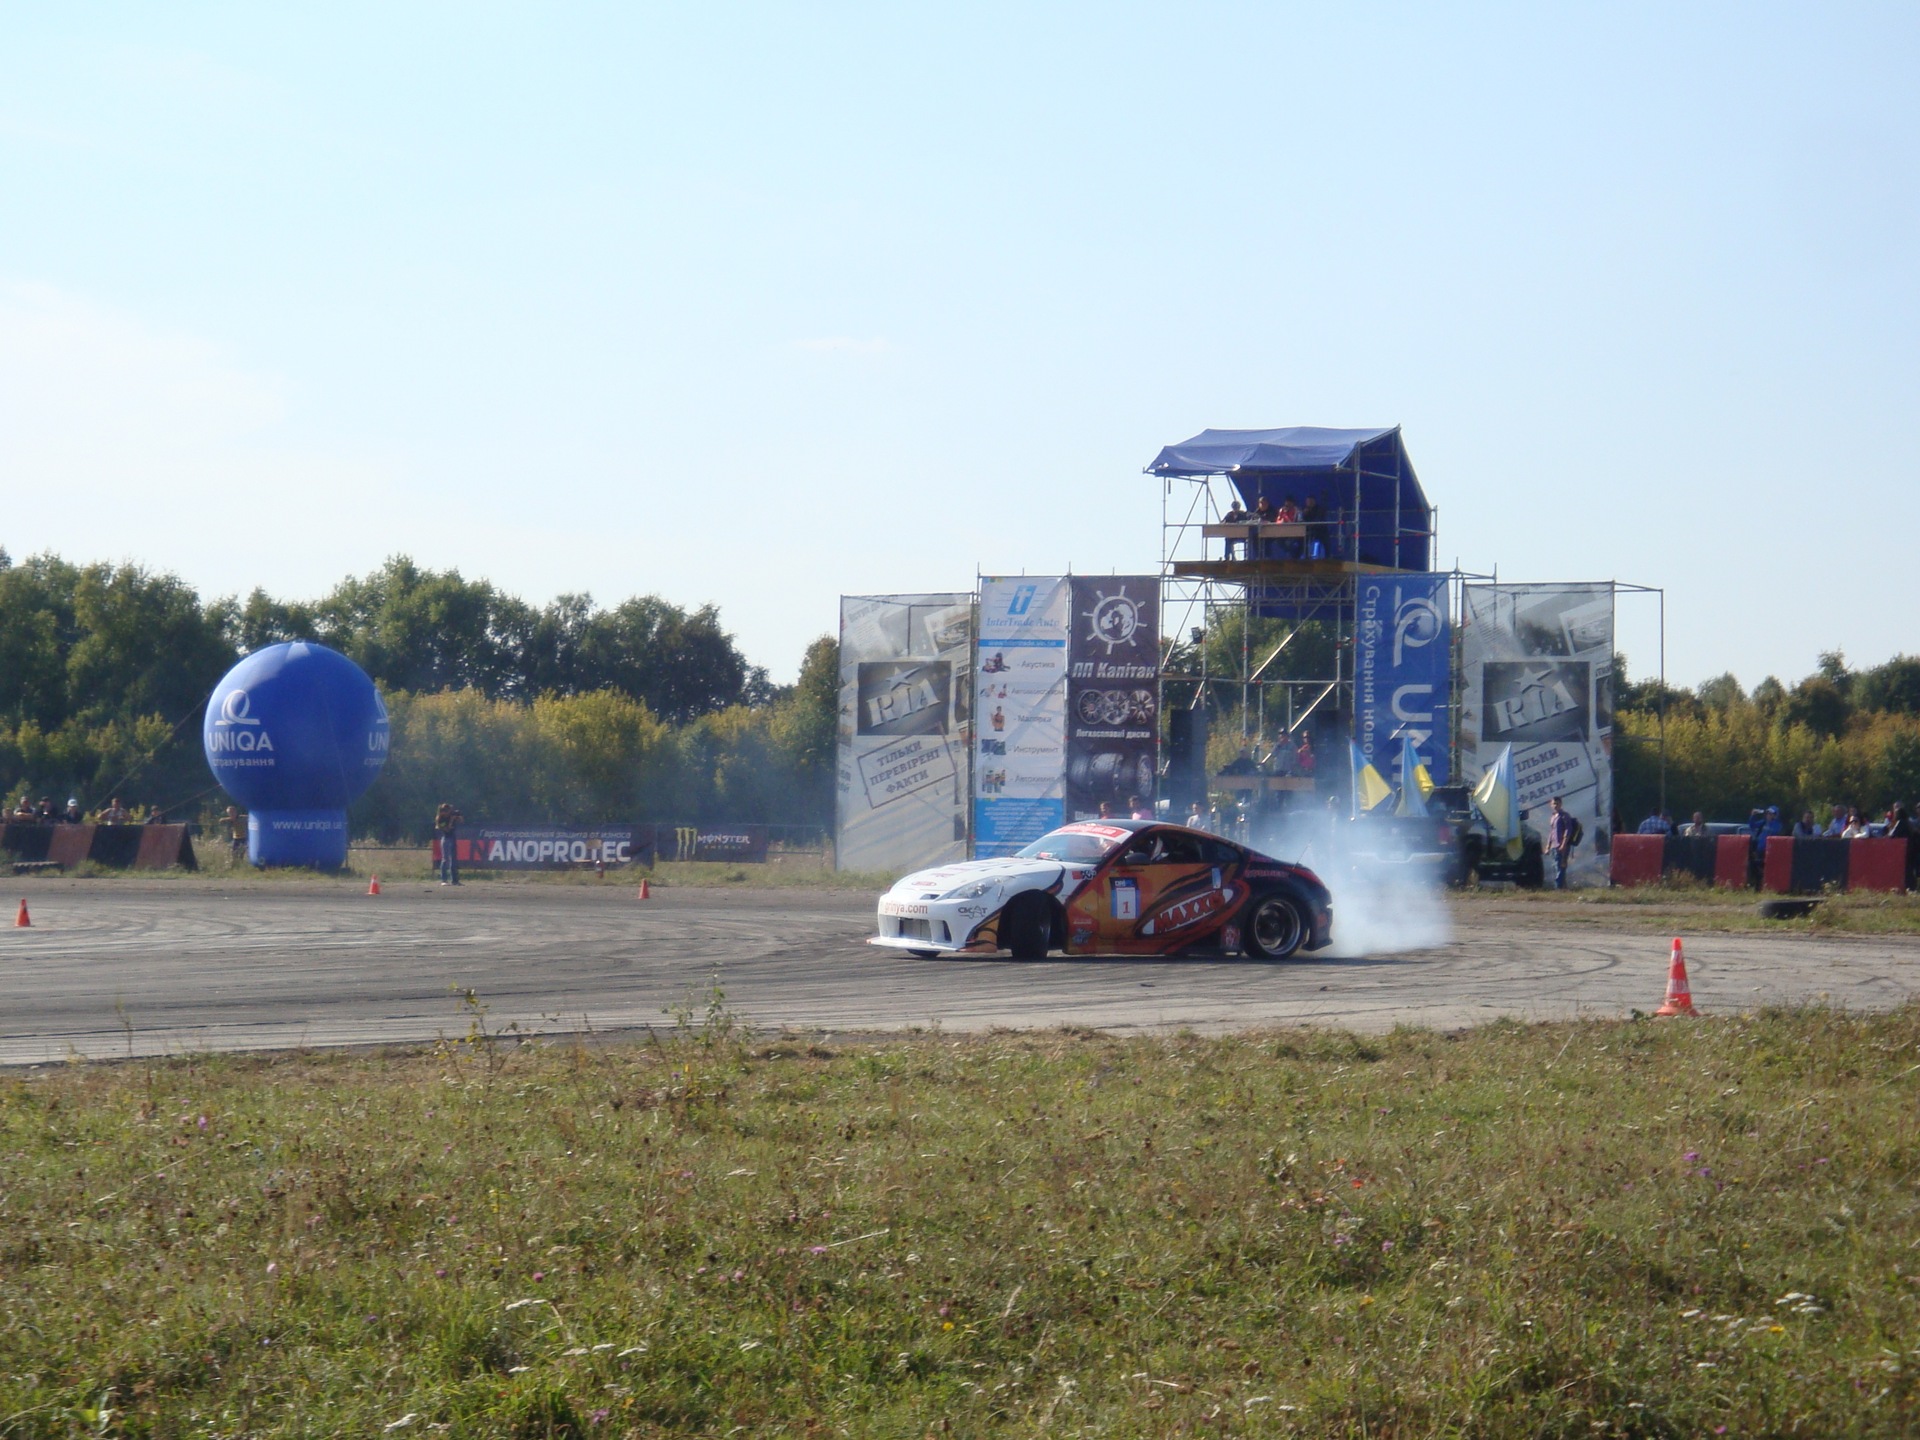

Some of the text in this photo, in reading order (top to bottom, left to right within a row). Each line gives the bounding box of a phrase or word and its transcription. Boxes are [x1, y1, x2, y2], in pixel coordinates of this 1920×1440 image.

[1360, 584, 1381, 704] Страхування
[1072, 662, 1156, 678] ПП Капітан
[866, 678, 941, 727] RIA
[1492, 680, 1580, 733] RIA
[209, 732, 273, 751] UNIQA
[877, 741, 922, 766] ТІЛЬКИ
[870, 749, 940, 786] ПЕРЕВІРЕНІ
[1514, 748, 1560, 773] ІЛЬКИ
[1516, 757, 1580, 789] РЕВІРЕНІ
[886, 769, 929, 793] ФАКТИ
[697, 834, 750, 843] MONSTER
[1122, 901, 1131, 914] 1
